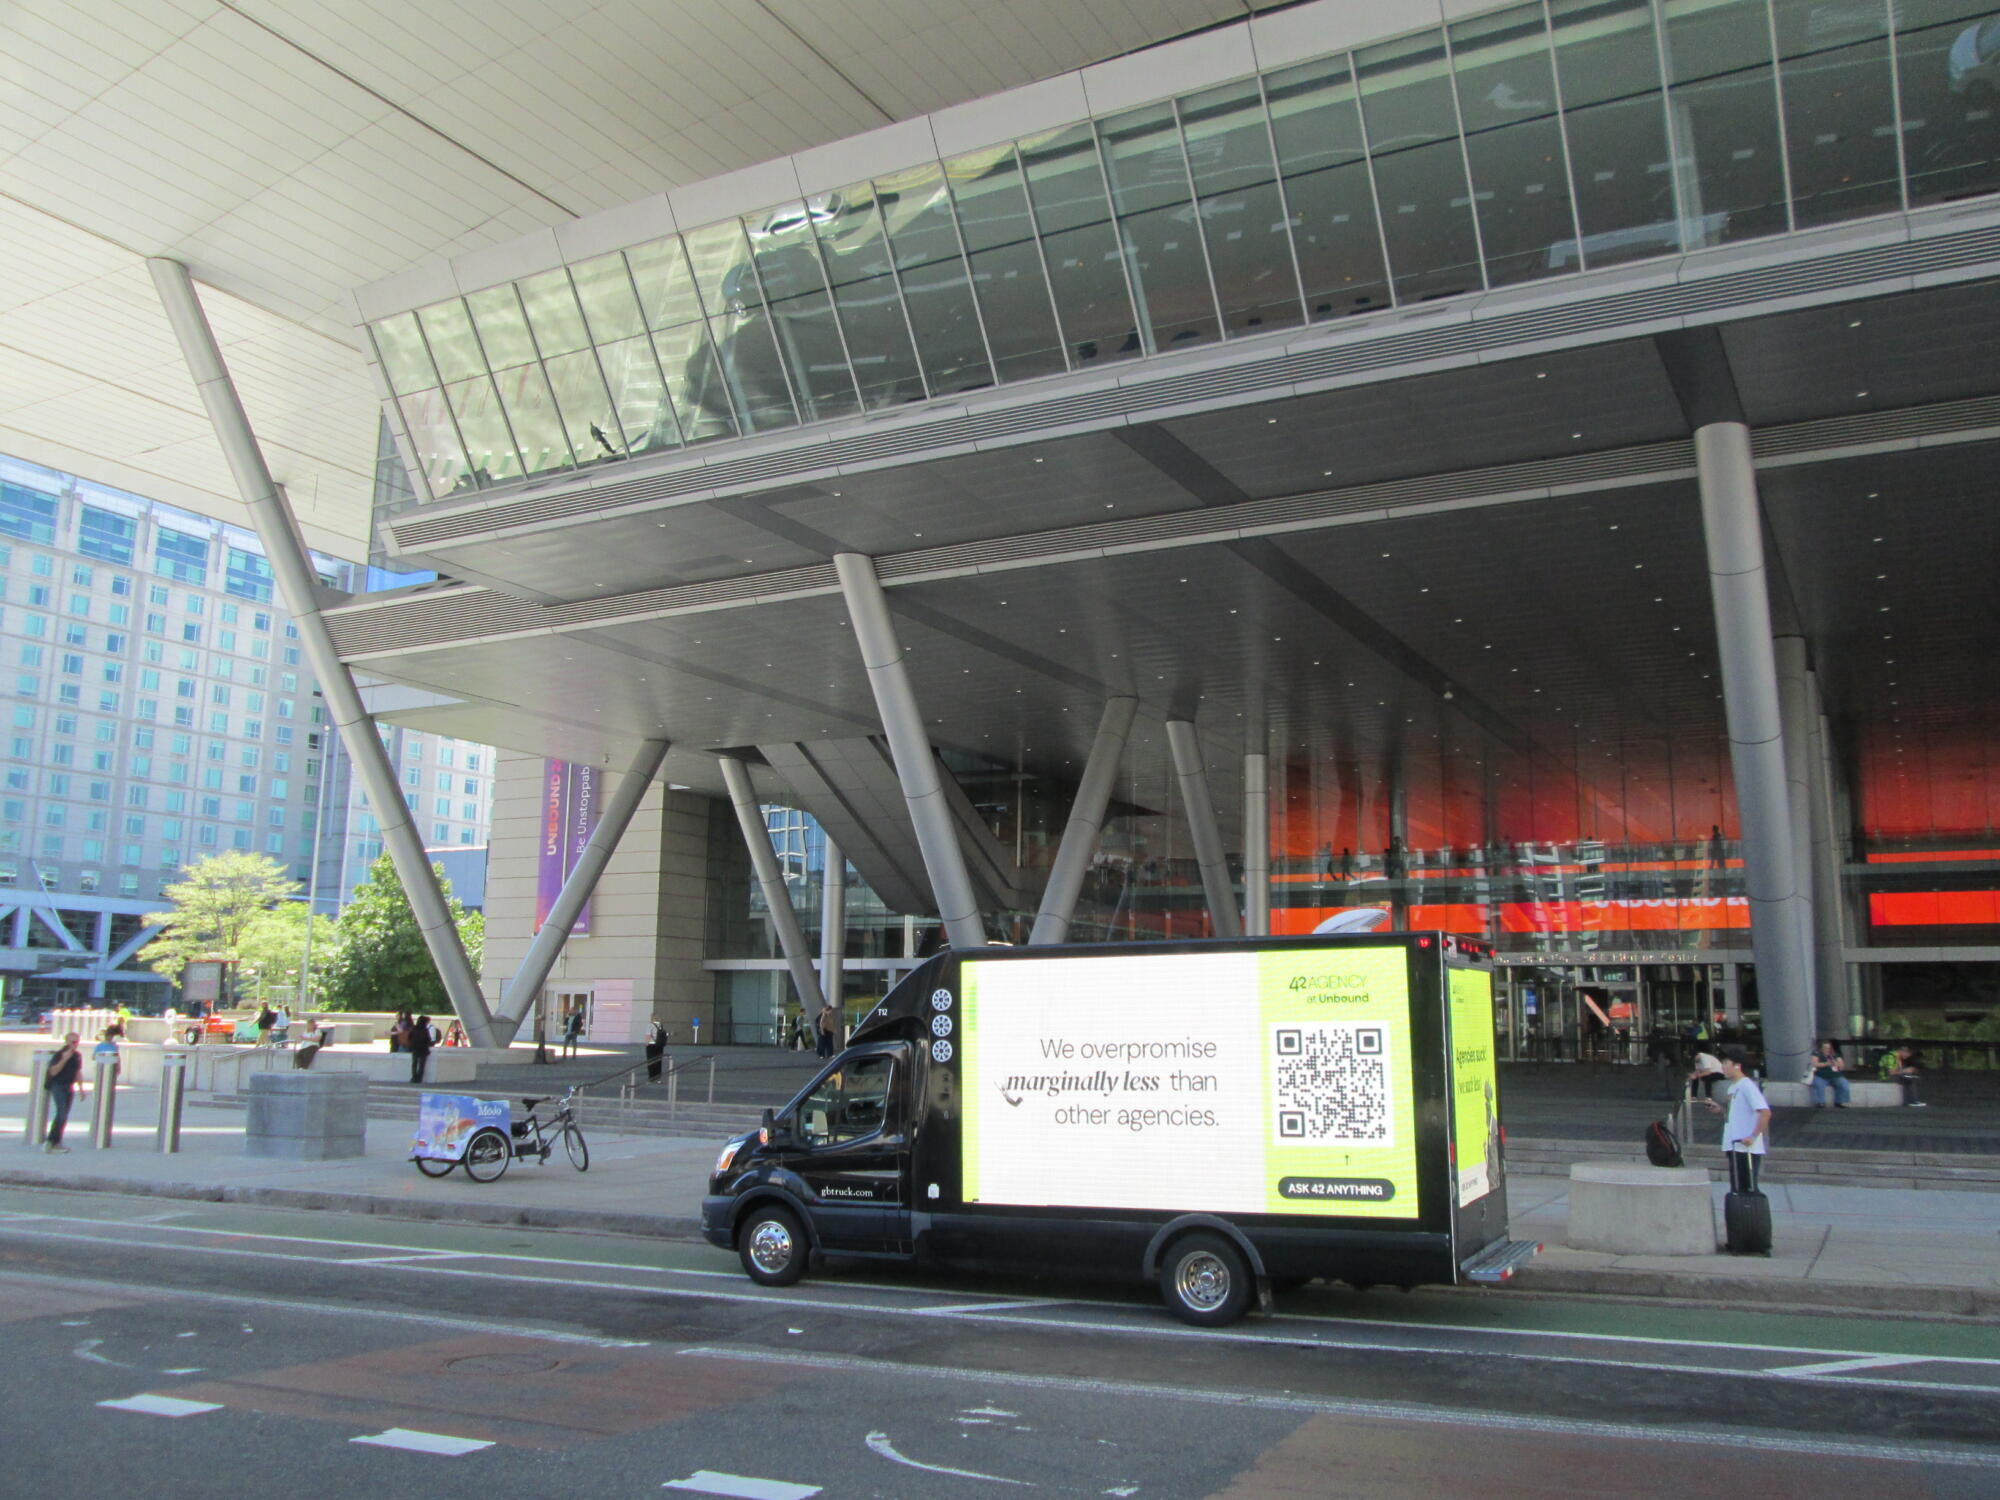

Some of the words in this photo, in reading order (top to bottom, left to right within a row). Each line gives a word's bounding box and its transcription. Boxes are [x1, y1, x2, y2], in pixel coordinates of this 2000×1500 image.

[547, 774, 561, 855] UNBOUND
[1319, 993, 1369, 1004] Unbound
[1040, 1038, 1075, 1060] We
[1080, 1036, 1217, 1064] overpromise
[1006, 1070, 1119, 1097] marginally
[1123, 1070, 1160, 1092] less
[1170, 1069, 1218, 1092] than
[1055, 1103, 1111, 1125] other
[1117, 1104, 1220, 1132] agencies.
[821, 1185, 873, 1198] gbtruck.com
[1288, 1183, 1310, 1194] ASK
[1311, 1184, 1325, 1195] 42
[1326, 1184, 1384, 1196] ANYTHING
